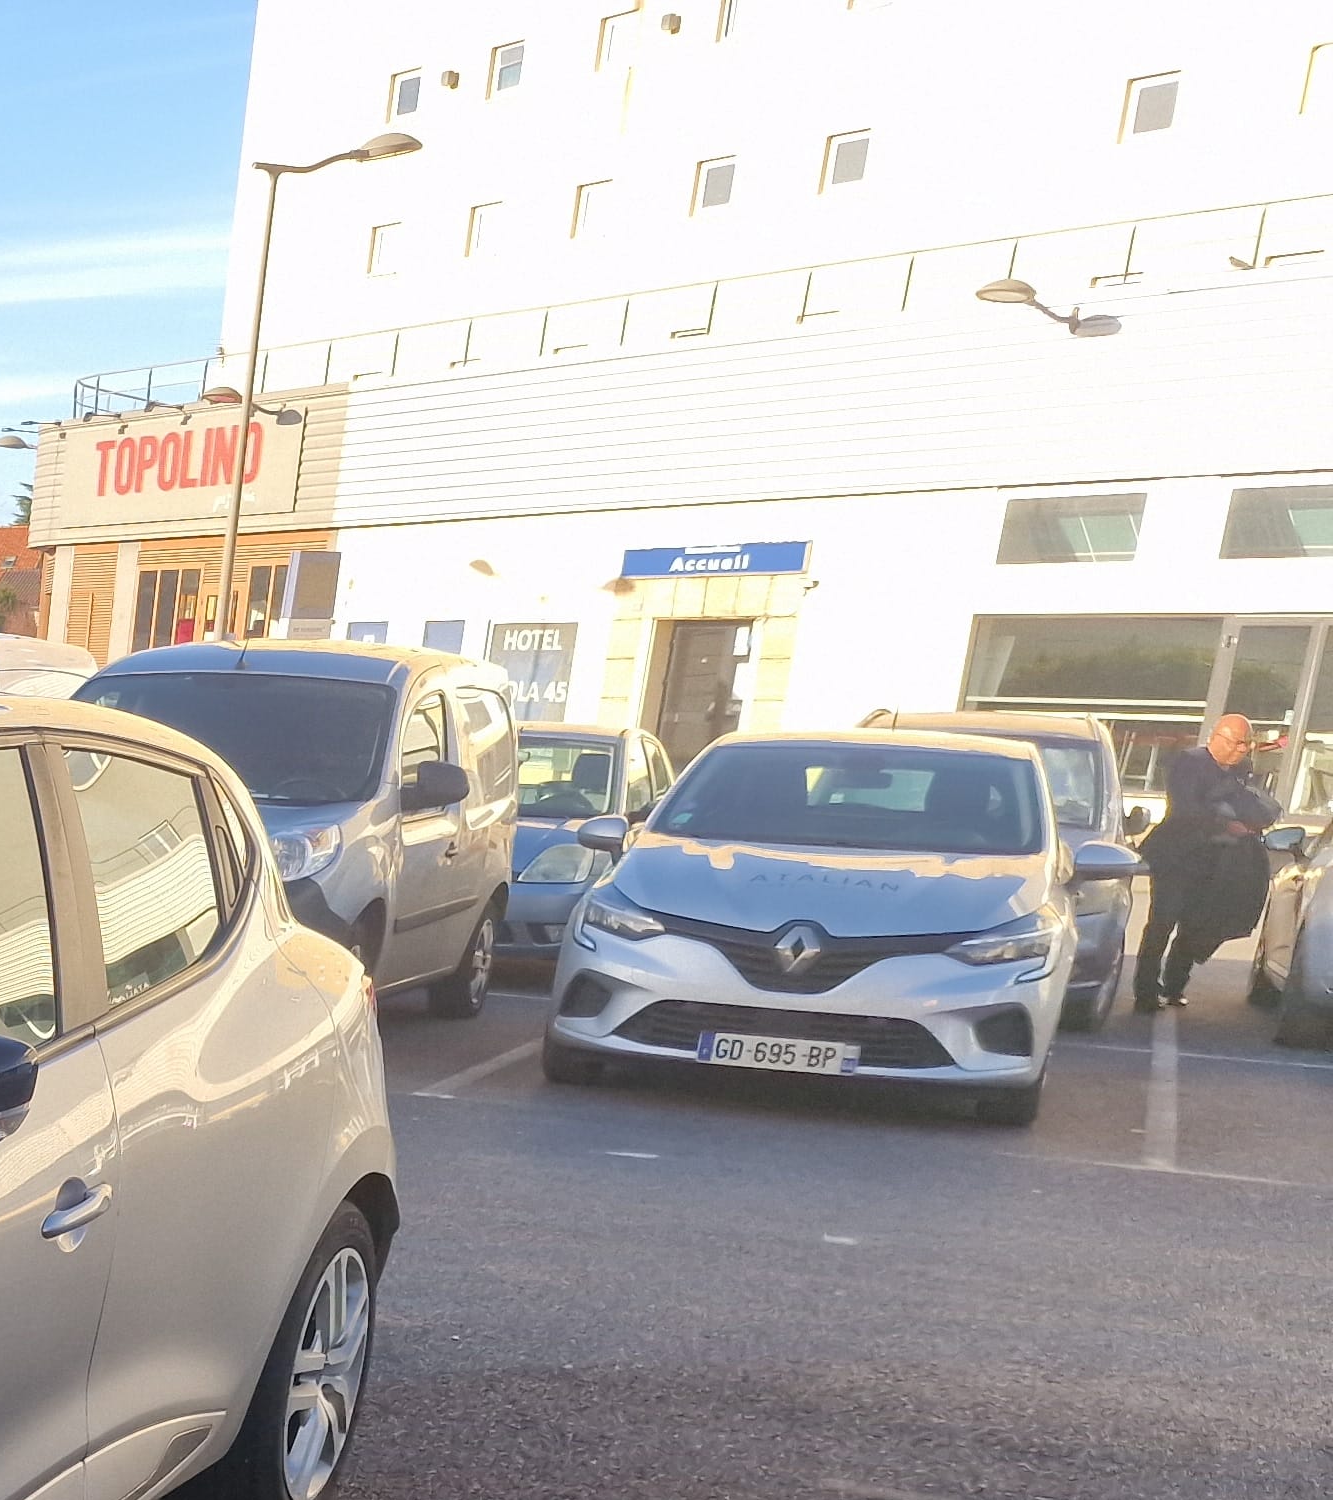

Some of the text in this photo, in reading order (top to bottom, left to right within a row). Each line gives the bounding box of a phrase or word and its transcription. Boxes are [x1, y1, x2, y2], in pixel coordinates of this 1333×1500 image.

[95, 422, 264, 497] TOPOLINO
[669, 553, 750, 573] Accueil
[502, 629, 562, 651] HOTEL
[543, 681, 568, 703] 45
